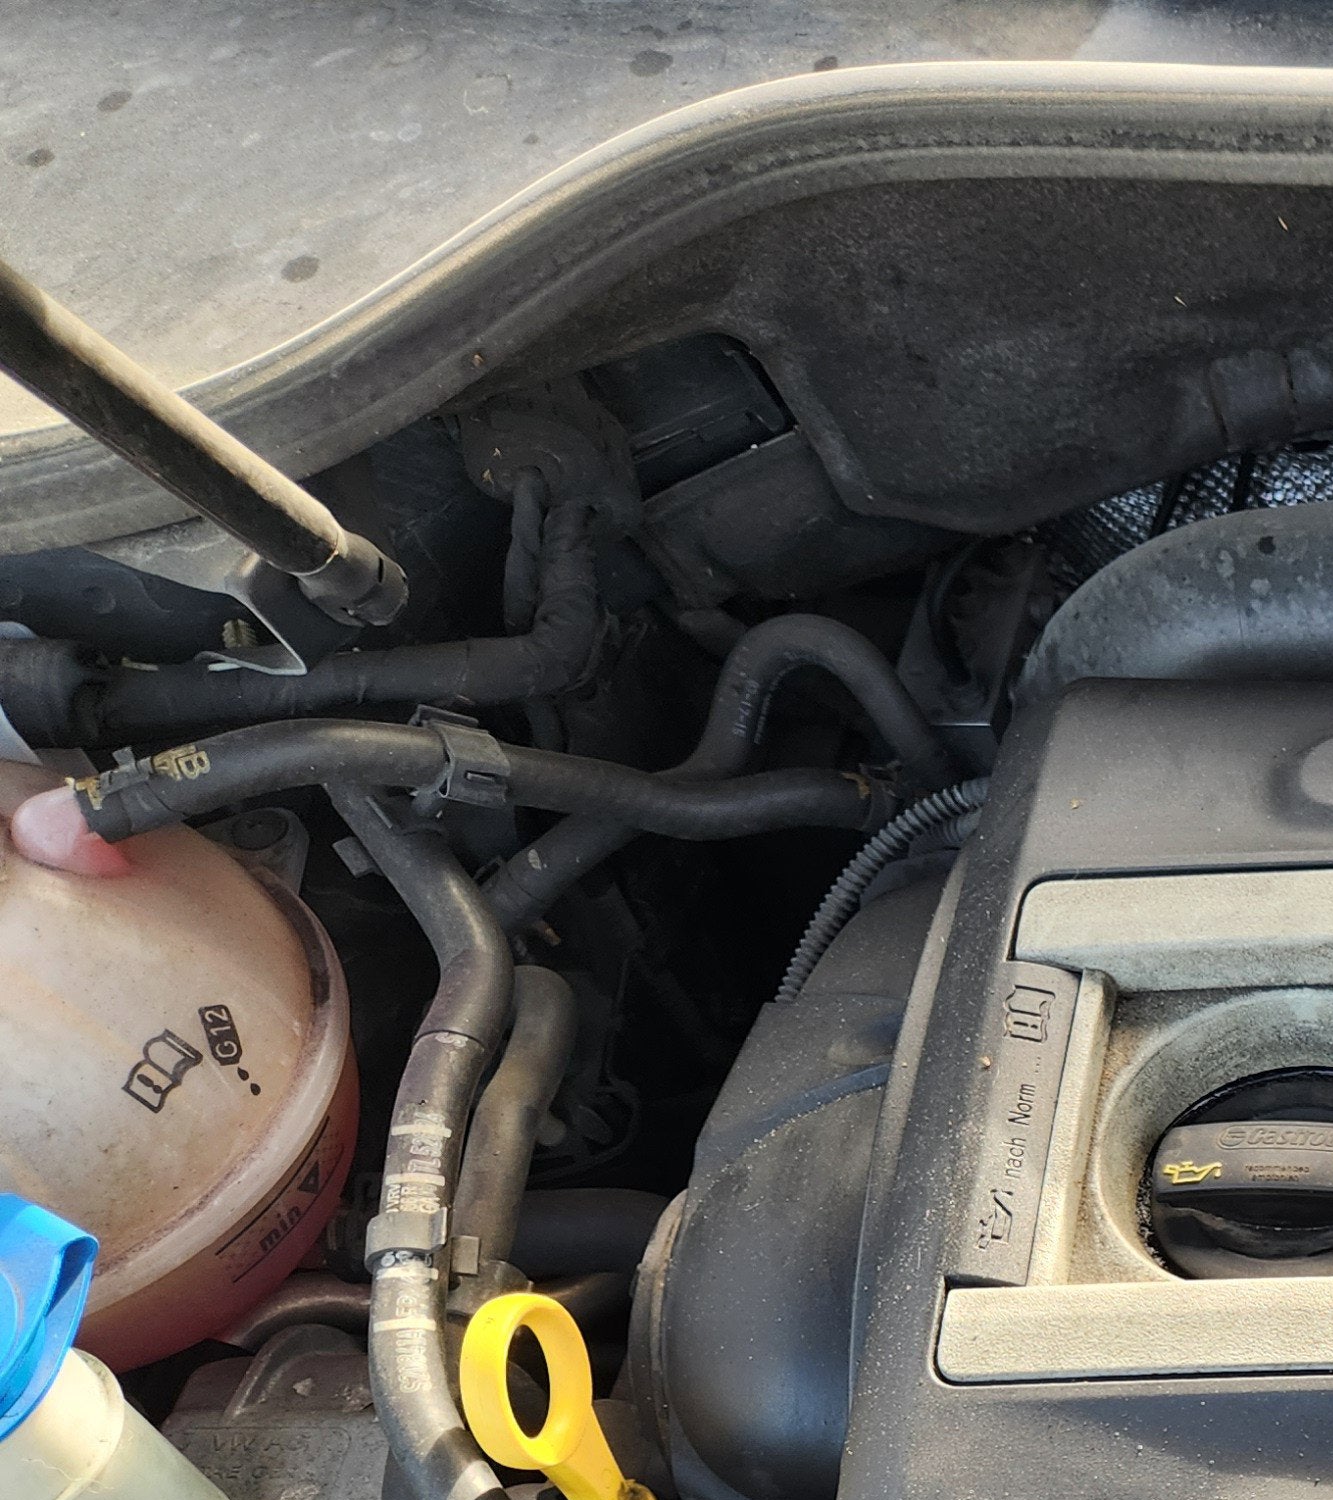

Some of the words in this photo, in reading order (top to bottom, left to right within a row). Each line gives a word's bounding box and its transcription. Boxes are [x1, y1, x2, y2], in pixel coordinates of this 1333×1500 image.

[1008, 1083, 1036, 1126] Norm
[1003, 1137, 1027, 1179] nach
[258, 1205, 301, 1251] min
